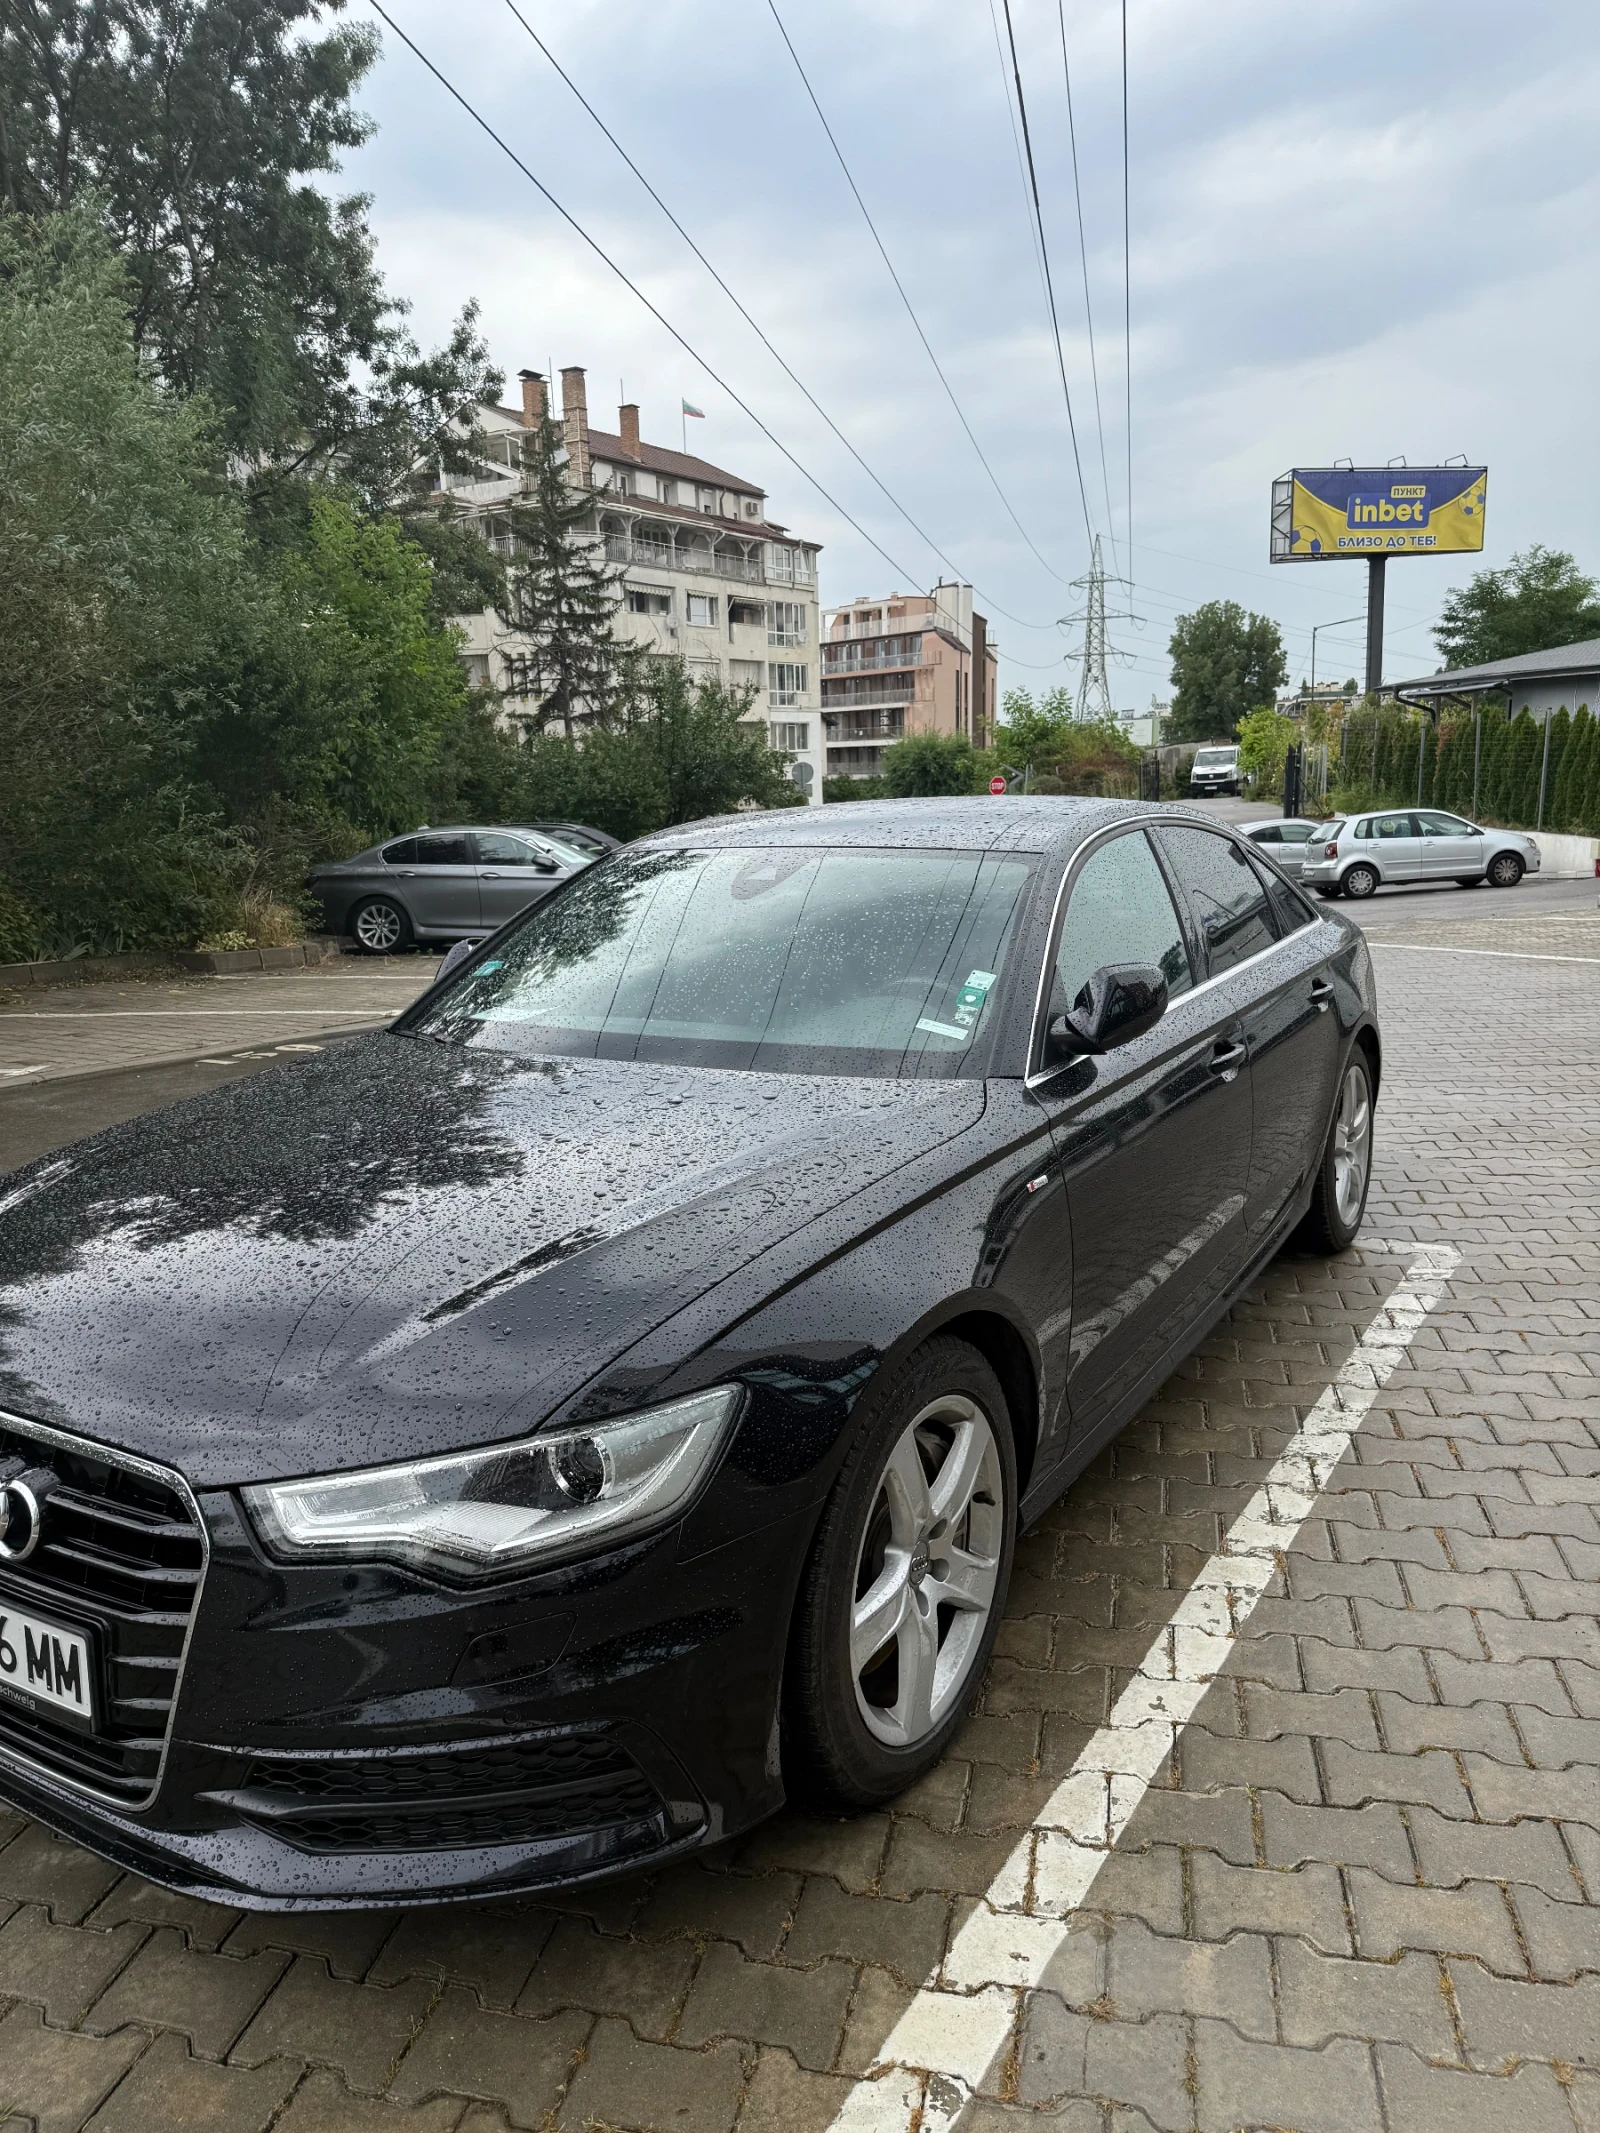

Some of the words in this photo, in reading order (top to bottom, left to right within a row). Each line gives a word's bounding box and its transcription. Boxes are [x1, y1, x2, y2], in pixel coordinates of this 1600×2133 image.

[1393, 487, 1424, 496] ПУНКТ
[1354, 498, 1424, 522] inbet
[1338, 536, 1383, 547] БЛИЗО
[1386, 536, 1406, 548] ДО
[1409, 535, 1437, 546] ТЕБ!
[991, 782, 1004, 790] STOP
[24, 1624, 82, 1704] MM
